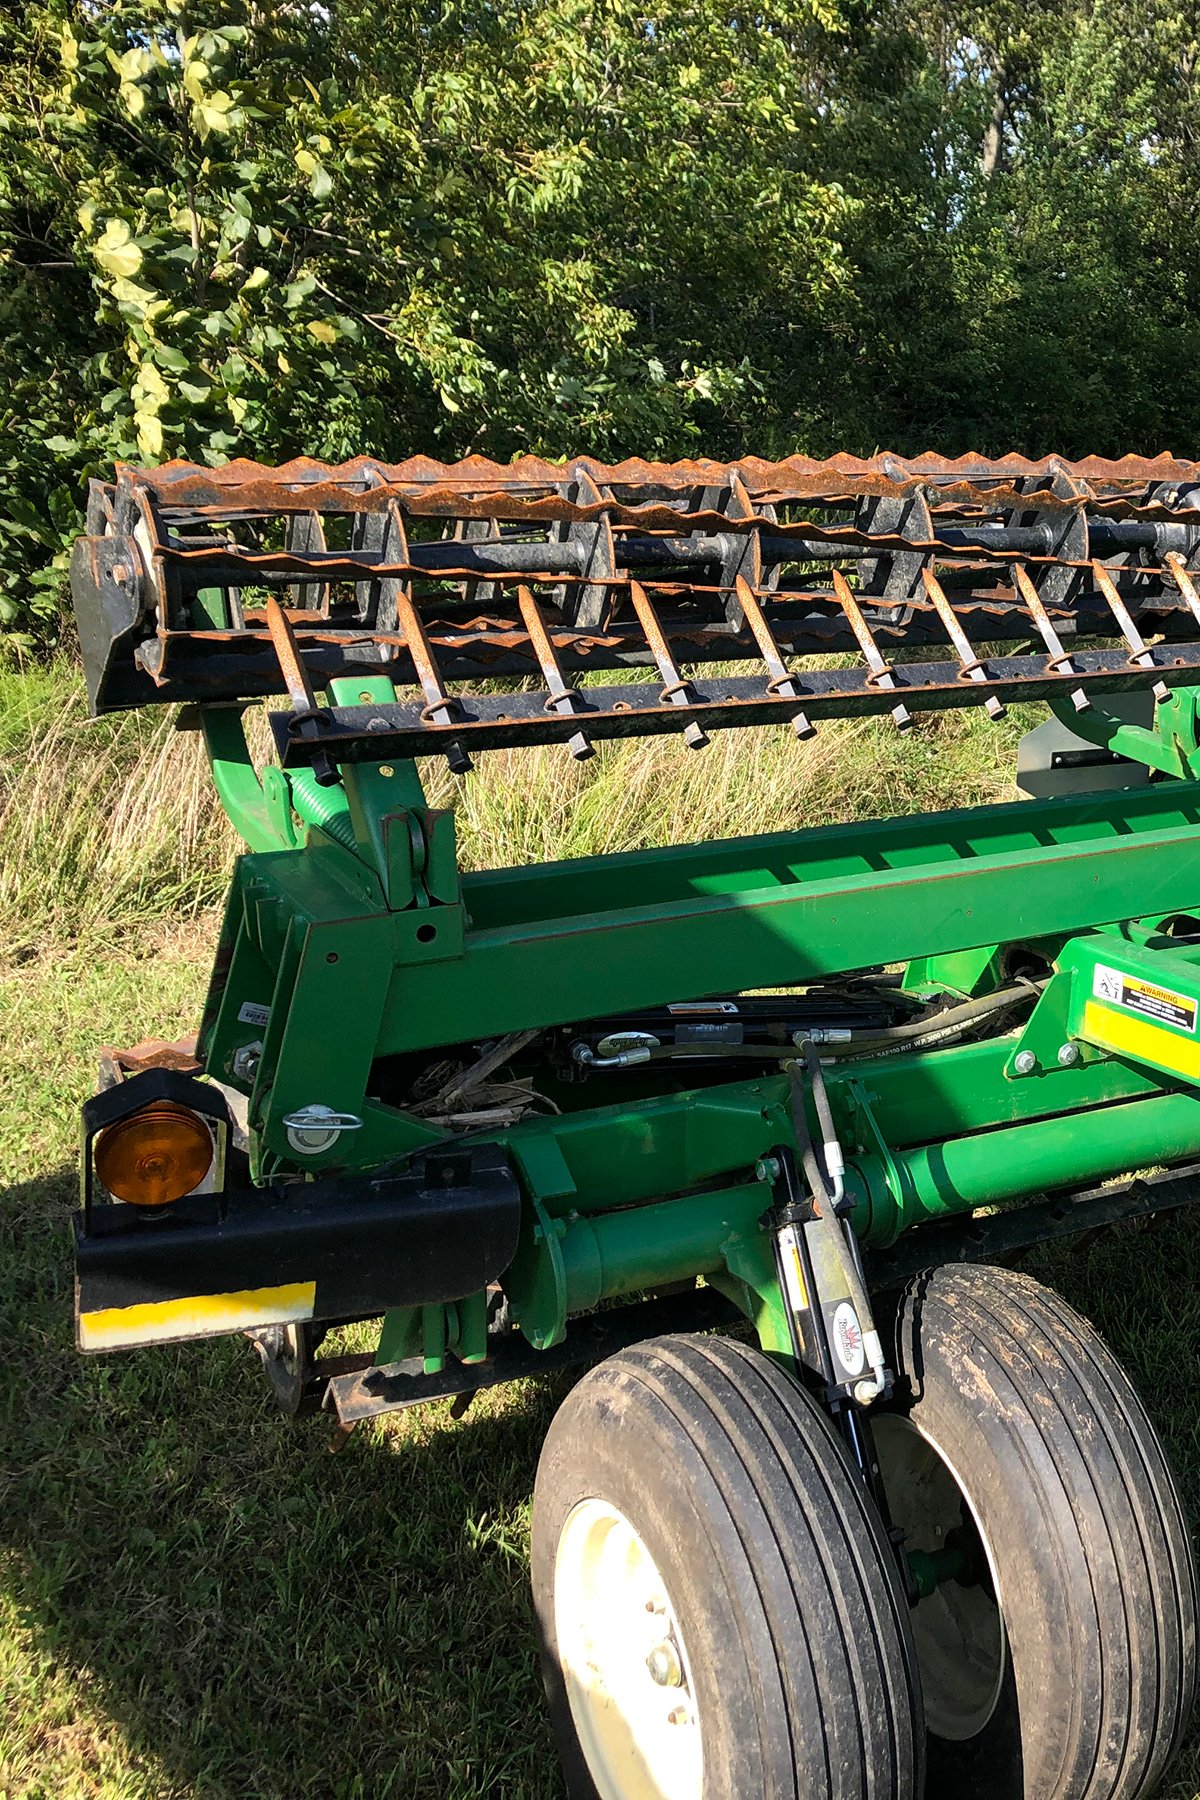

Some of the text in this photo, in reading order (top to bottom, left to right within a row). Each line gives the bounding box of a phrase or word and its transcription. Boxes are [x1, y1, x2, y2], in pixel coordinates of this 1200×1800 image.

[1145, 986, 1179, 1005] WARNING
[927, 1032, 942, 1044] 3000
[941, 1028, 952, 1038] PSI
